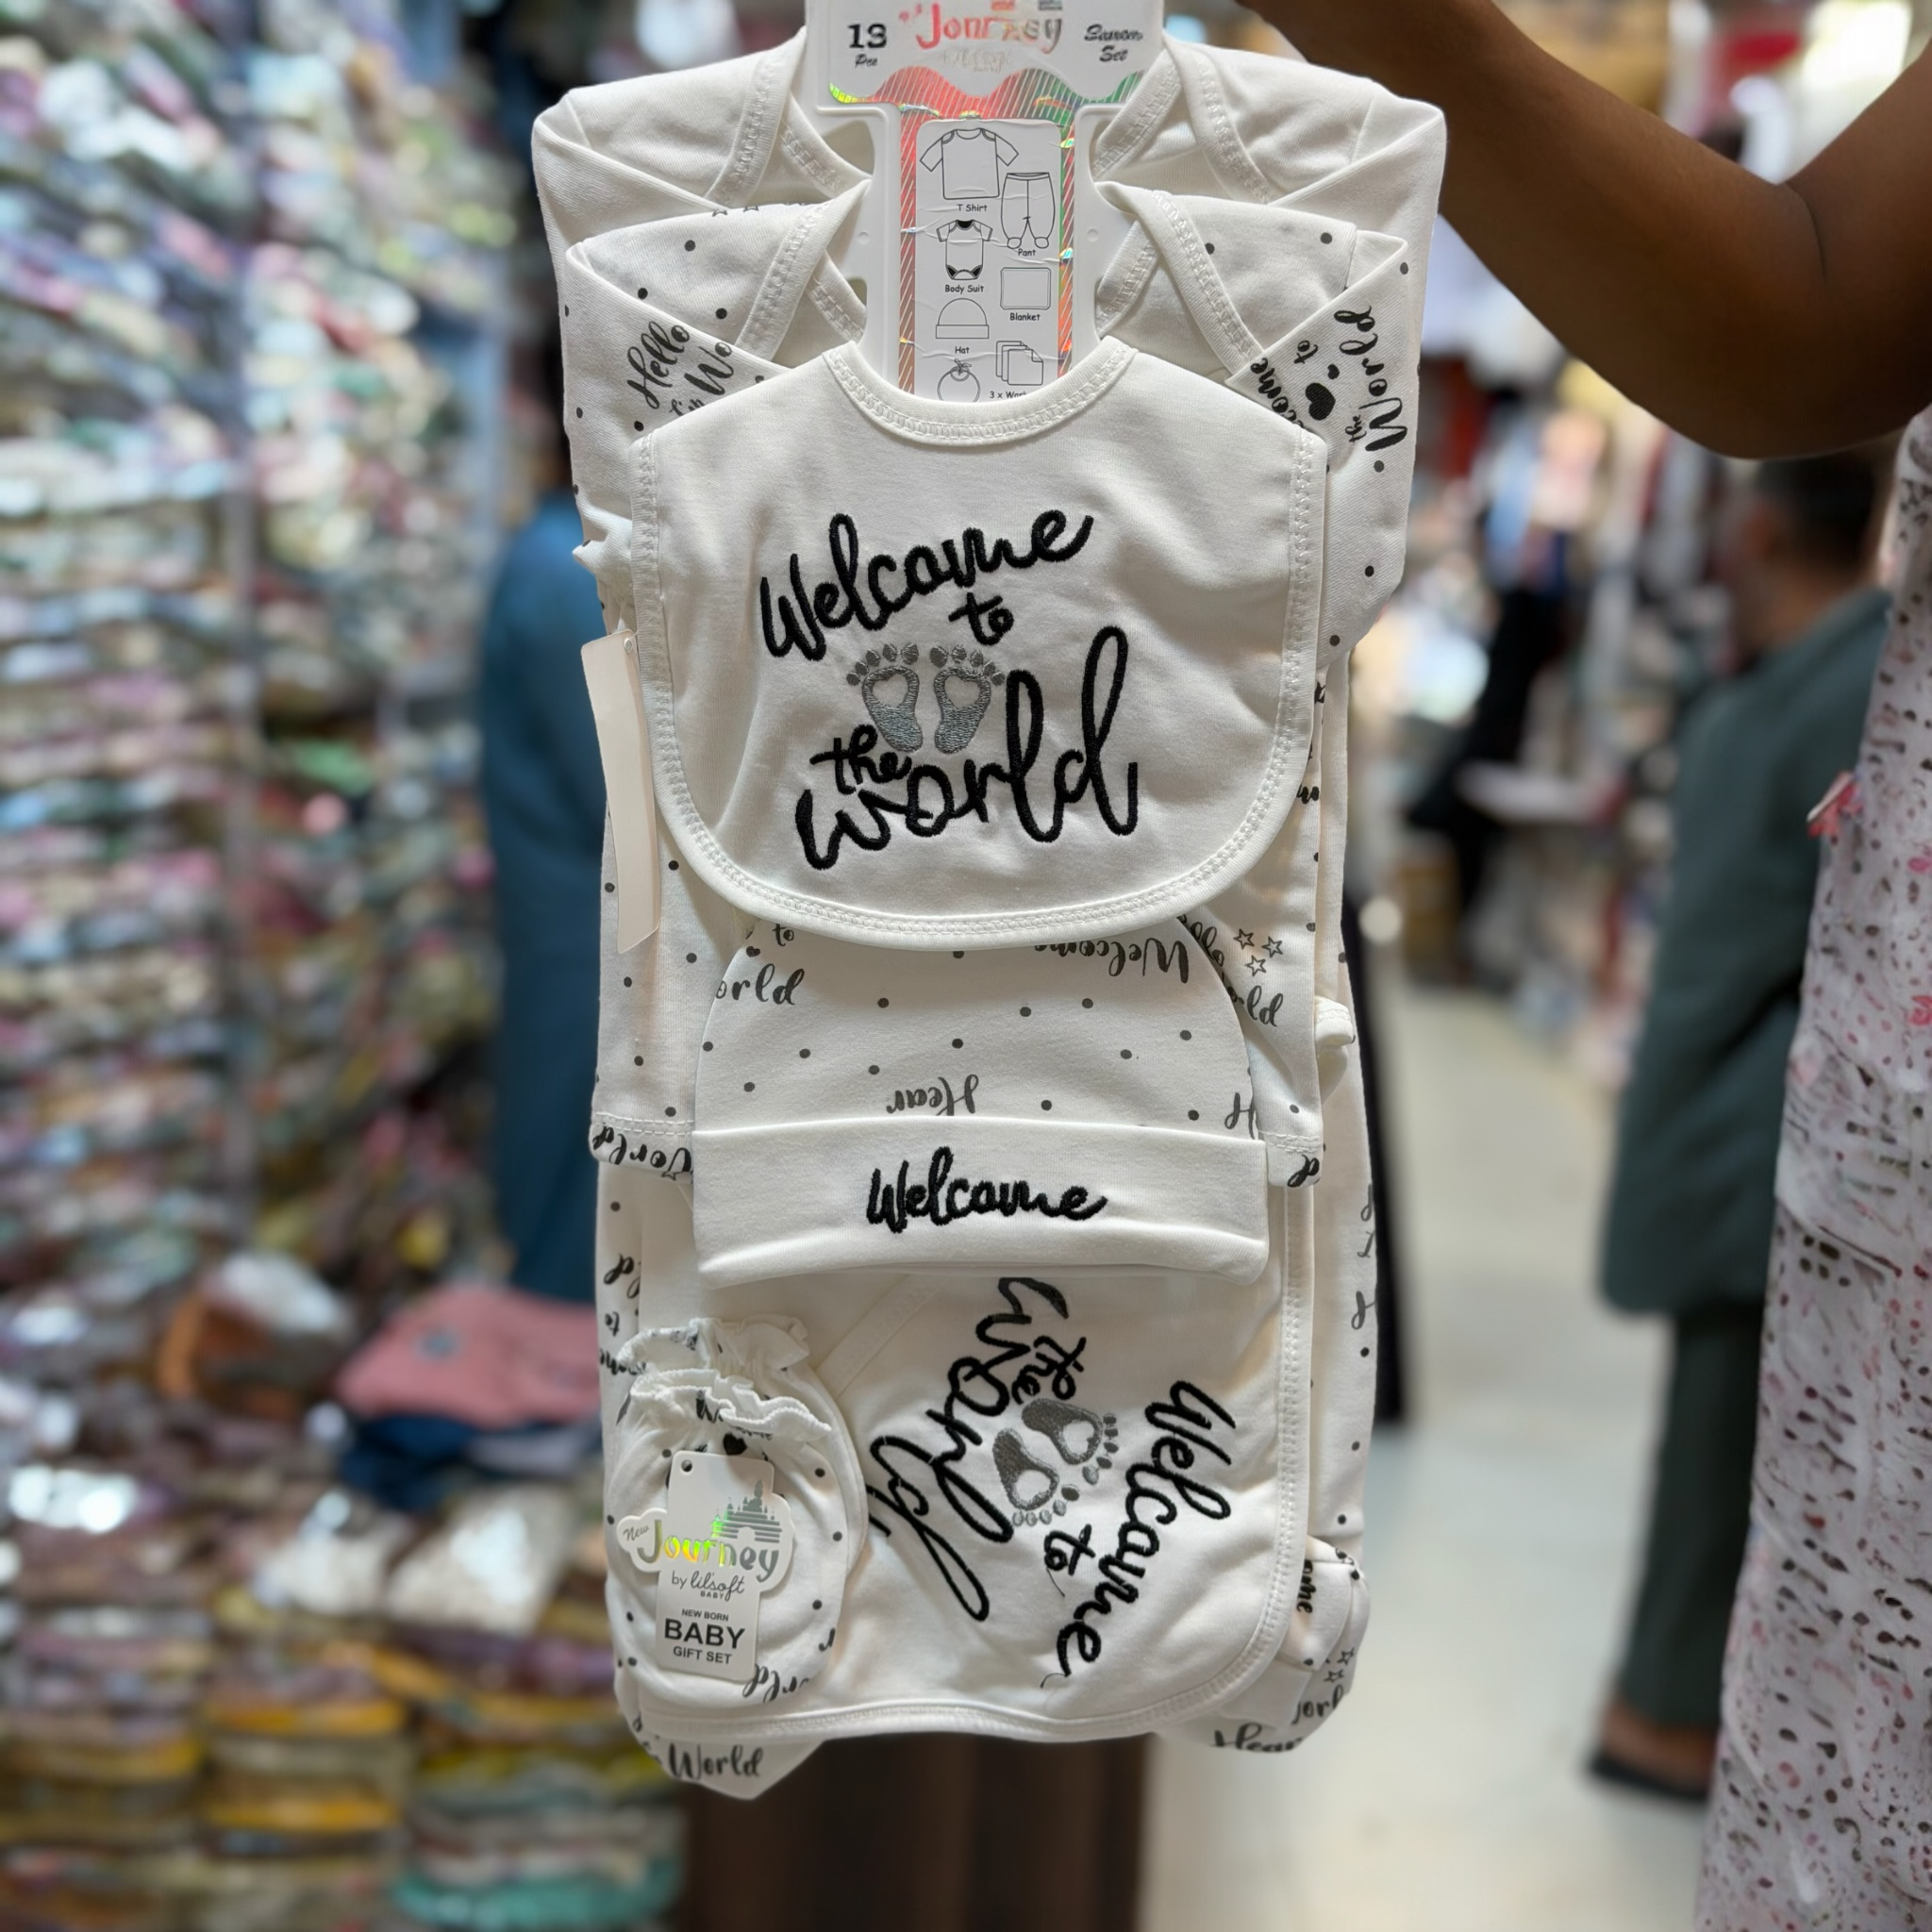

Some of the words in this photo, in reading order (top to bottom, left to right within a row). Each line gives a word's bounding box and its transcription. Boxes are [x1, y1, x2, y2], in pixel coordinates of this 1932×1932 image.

[965, 204, 988, 212] Shirt
[945, 285, 964, 294] Body
[1009, 313, 1041, 322] Blanket
[627, 321, 691, 410] Hello
[955, 346, 970, 355] Hat
[1334, 306, 1407, 451] World
[1345, 414, 1367, 443] the
[760, 509, 1094, 661] Welcome
[949, 592, 1014, 645] to
[810, 724, 912, 794] the
[866, 1145, 1108, 1234] Welcome
[1011, 1336, 1087, 1405] the
[624, 1524, 650, 1541] New
[1056, 1381, 1237, 1677] Welcome
[636, 1519, 780, 1583] Journey
[1043, 1524, 1095, 1575] to
[672, 1570, 688, 1590] by
[700, 1591, 725, 1599] BABY
[681, 1608, 702, 1619] NEW
[704, 1610, 729, 1622] BORN
[664, 1618, 746, 1649] BABY
[673, 1645, 703, 1660] GIFT
[706, 1651, 732, 1664] SET
[668, 1742, 764, 1781] World
